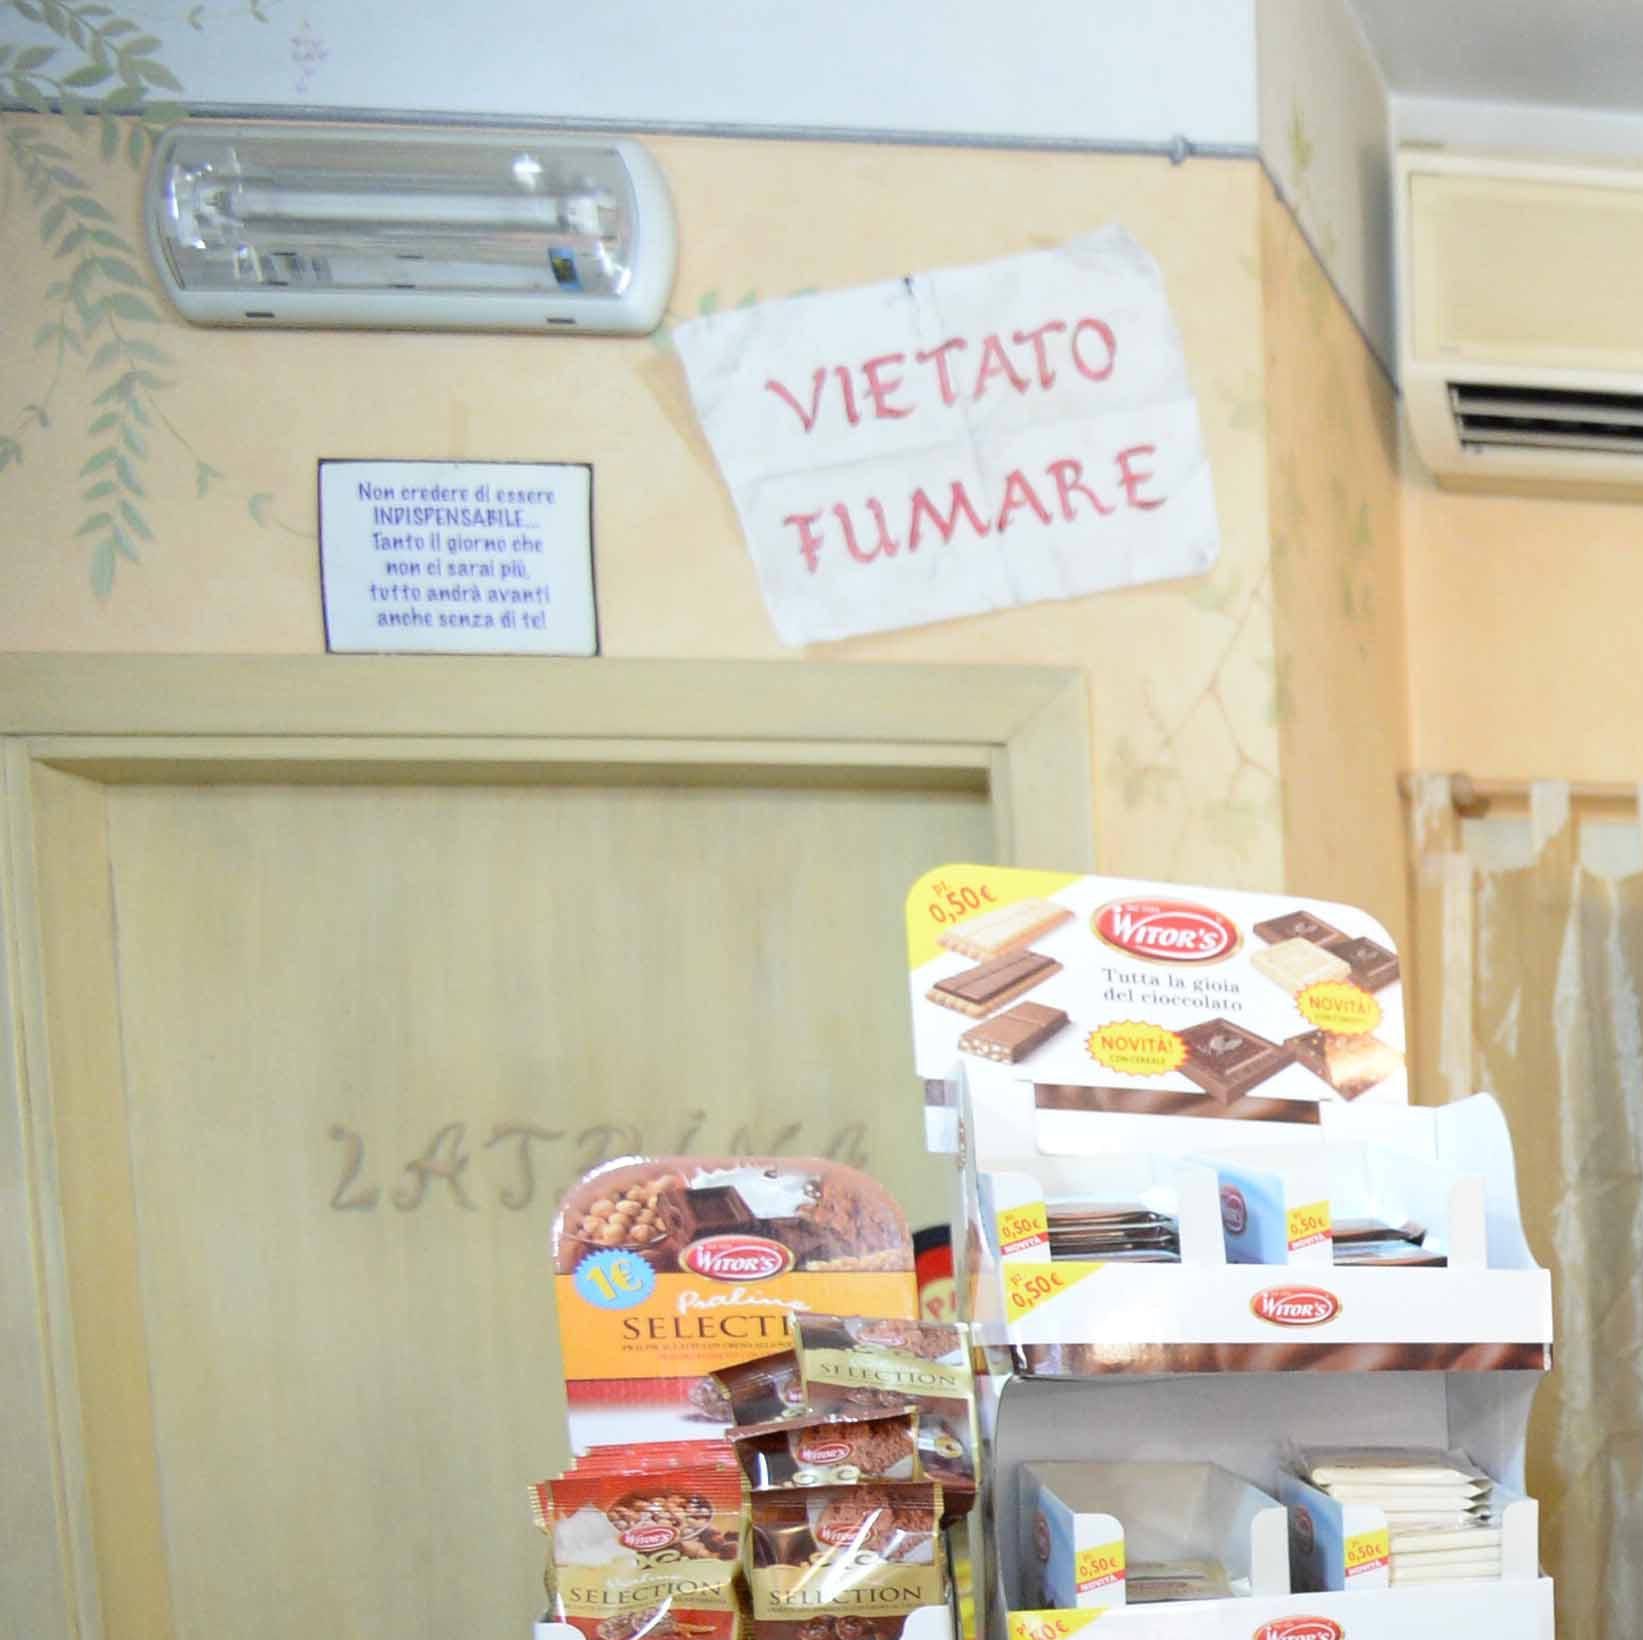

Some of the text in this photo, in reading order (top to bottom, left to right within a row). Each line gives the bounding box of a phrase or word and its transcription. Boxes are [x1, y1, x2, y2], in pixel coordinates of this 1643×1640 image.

[765, 318, 1118, 433] VIETATO
[358, 482, 556, 504] Non credere di essere
[783, 444, 1169, 574] FUMARE
[372, 532, 424, 551] Tanto
[447, 534, 507, 554] giorno
[512, 533, 544, 552] che
[386, 560, 421, 576] non
[427, 559, 441, 576] ci
[447, 559, 494, 577] sarai
[370, 583, 550, 605] tutto andrà avanti
[377, 607, 433, 628] anche
[439, 611, 493, 629] senza
[500, 610, 517, 629] di
[1112, 908, 1219, 951] WITOR'S
[1102, 966, 1241, 997] Tutta la gioia
[1103, 988, 1245, 1012] del cioccolato
[1100, 1033, 1173, 1055] NOVITÀ!
[693, 1244, 783, 1273] WITOR'S
[1262, 1291, 1328, 1318] WITOR'S
[622, 1315, 792, 1341] SELECTI
[568, 1578, 722, 1605] SELECTION
